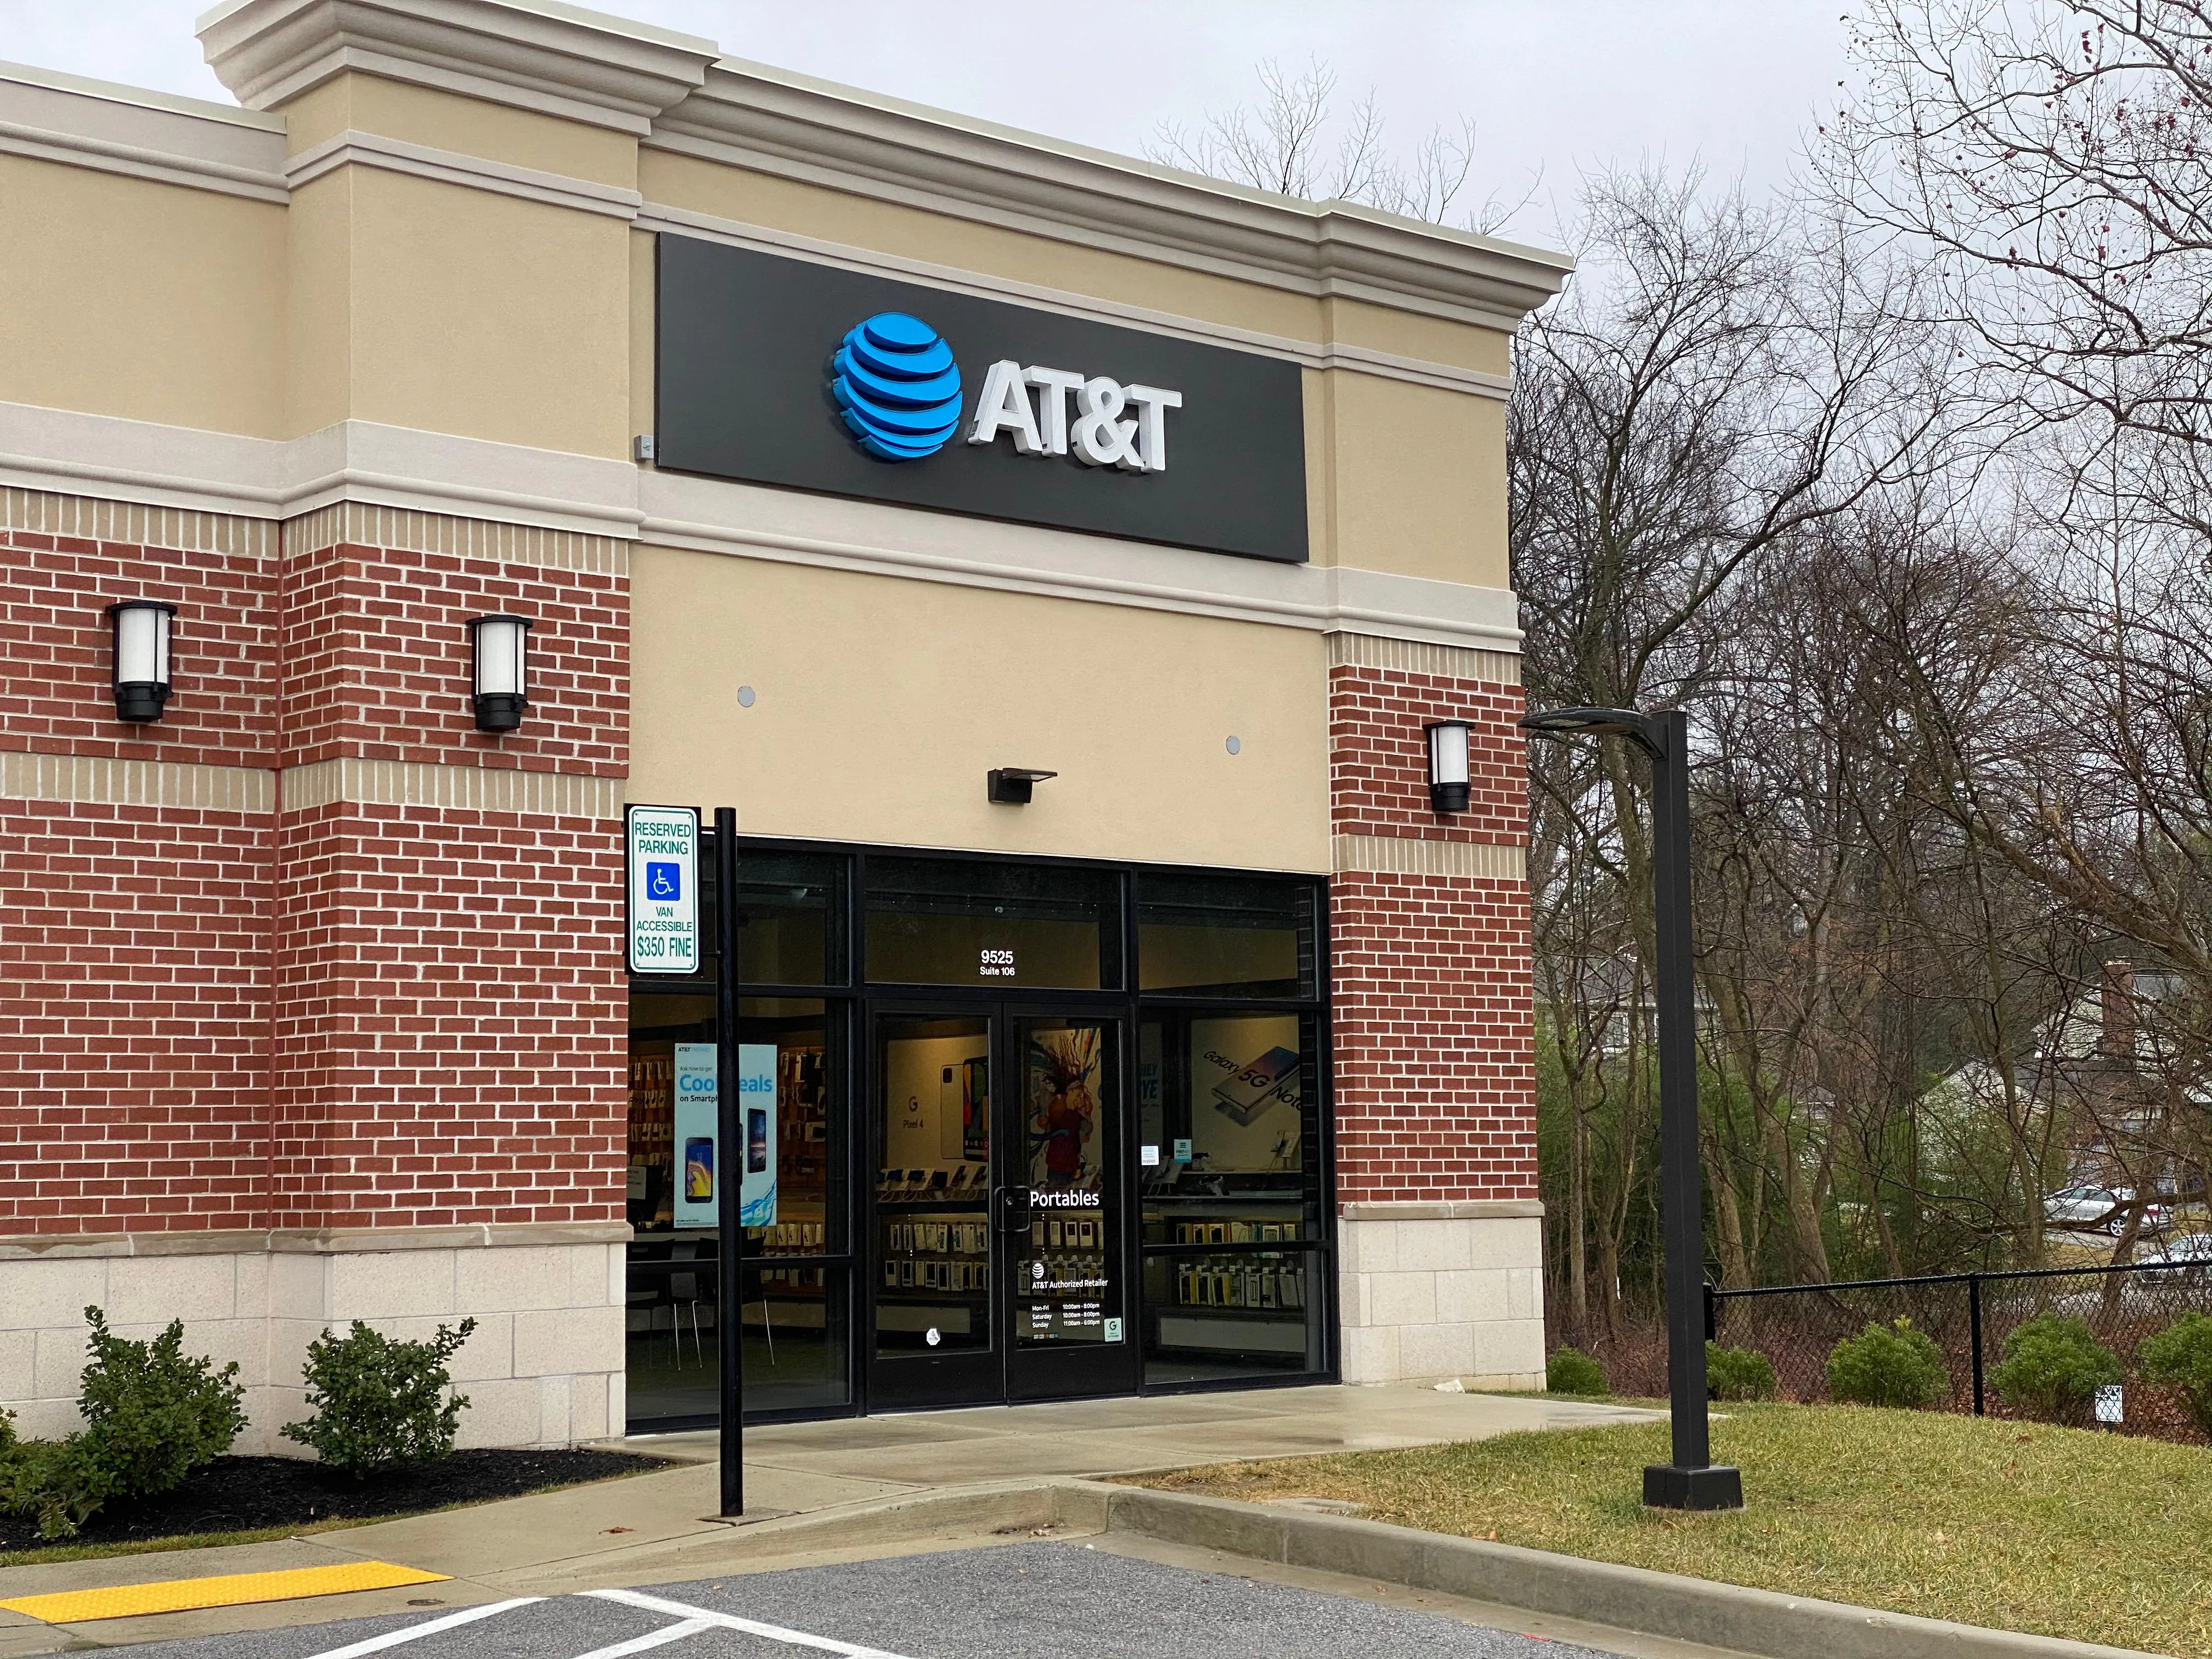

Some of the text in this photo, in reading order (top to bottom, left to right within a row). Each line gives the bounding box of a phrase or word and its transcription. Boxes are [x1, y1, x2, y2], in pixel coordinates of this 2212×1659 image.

[968, 359, 1182, 474] AT&T
[635, 822, 691, 838] RESERVED
[639, 839, 688, 855] PARKING
[656, 906, 673, 917] VAN
[636, 920, 692, 932] ACCESSIBLE
[637, 935, 692, 957] $350 FINE
[980, 950, 1014, 965] 9525
[980, 966, 1015, 977] Suite 106
[1203, 1050, 1241, 1075] Galaxy
[1238, 1069, 1270, 1088] 5G
[740, 1074, 772, 1092] eals
[903, 1119, 924, 1128] Pixel 4
[1030, 1189, 1099, 1207] Portables
[1032, 1279, 1108, 1289] AT&T Authorized Retailer
